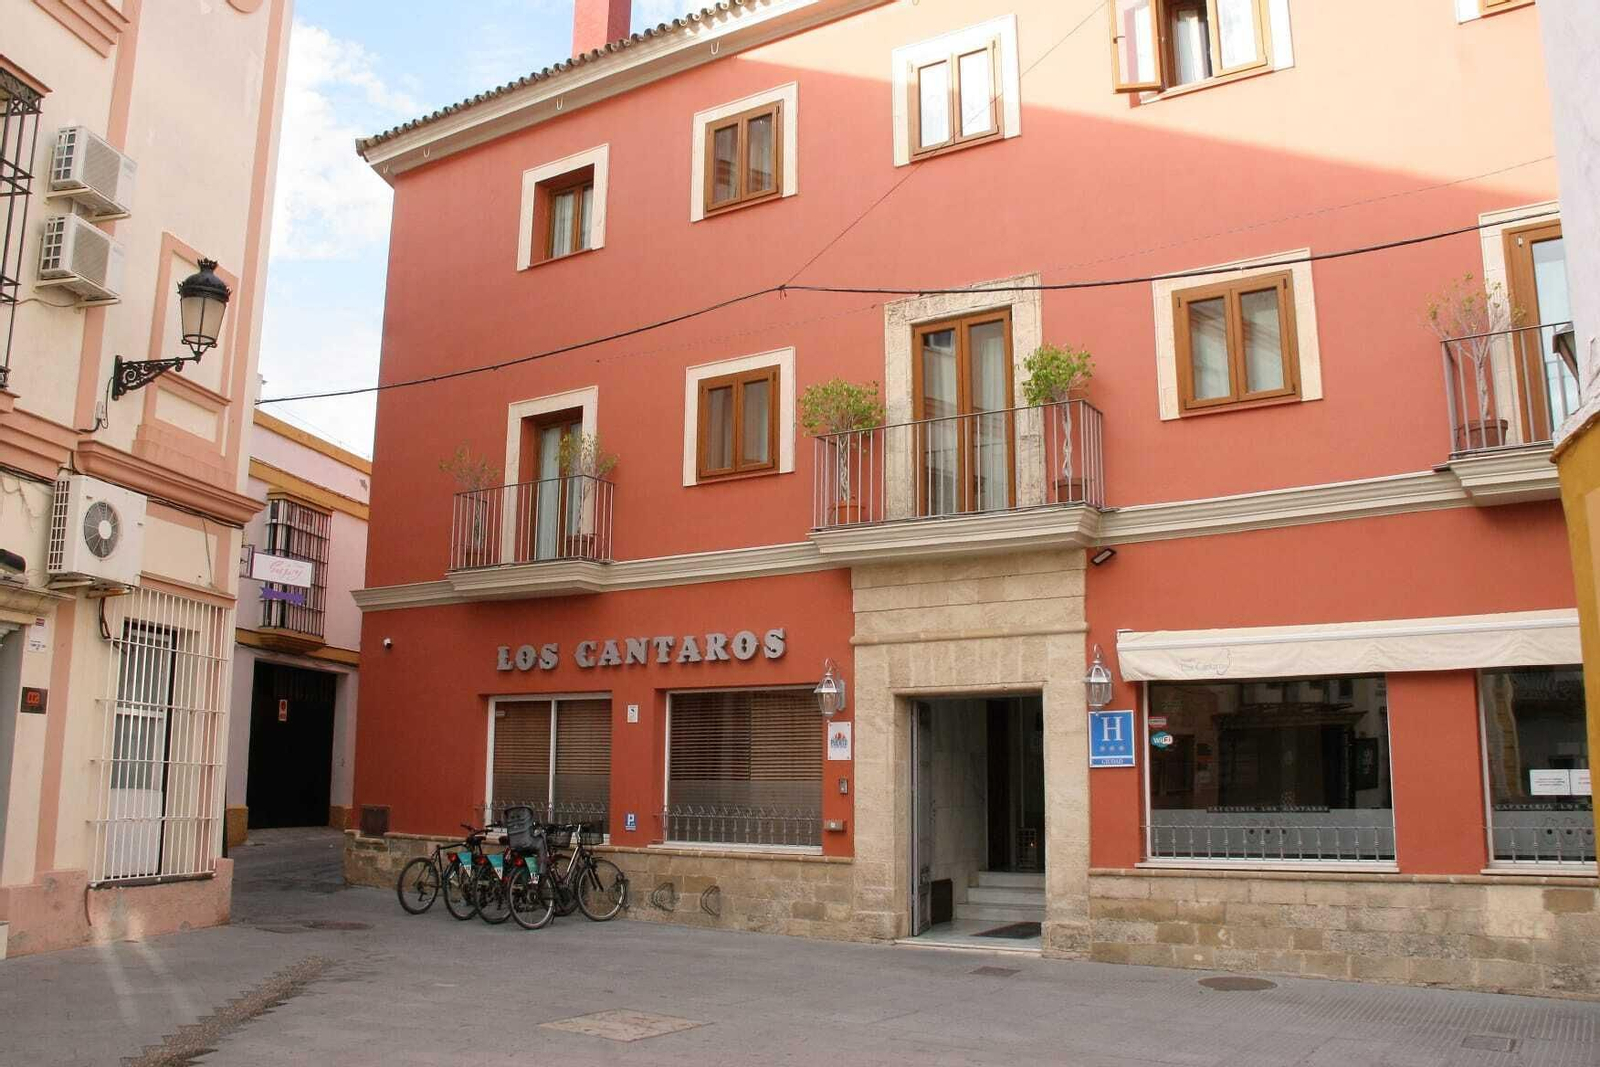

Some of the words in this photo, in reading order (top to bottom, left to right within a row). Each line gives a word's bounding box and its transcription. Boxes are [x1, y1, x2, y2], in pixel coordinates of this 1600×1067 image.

[496, 643, 559, 671] LOS
[575, 628, 786, 668] CANTAROS
[1101, 716, 1124, 742] H
[627, 813, 635, 826] P
